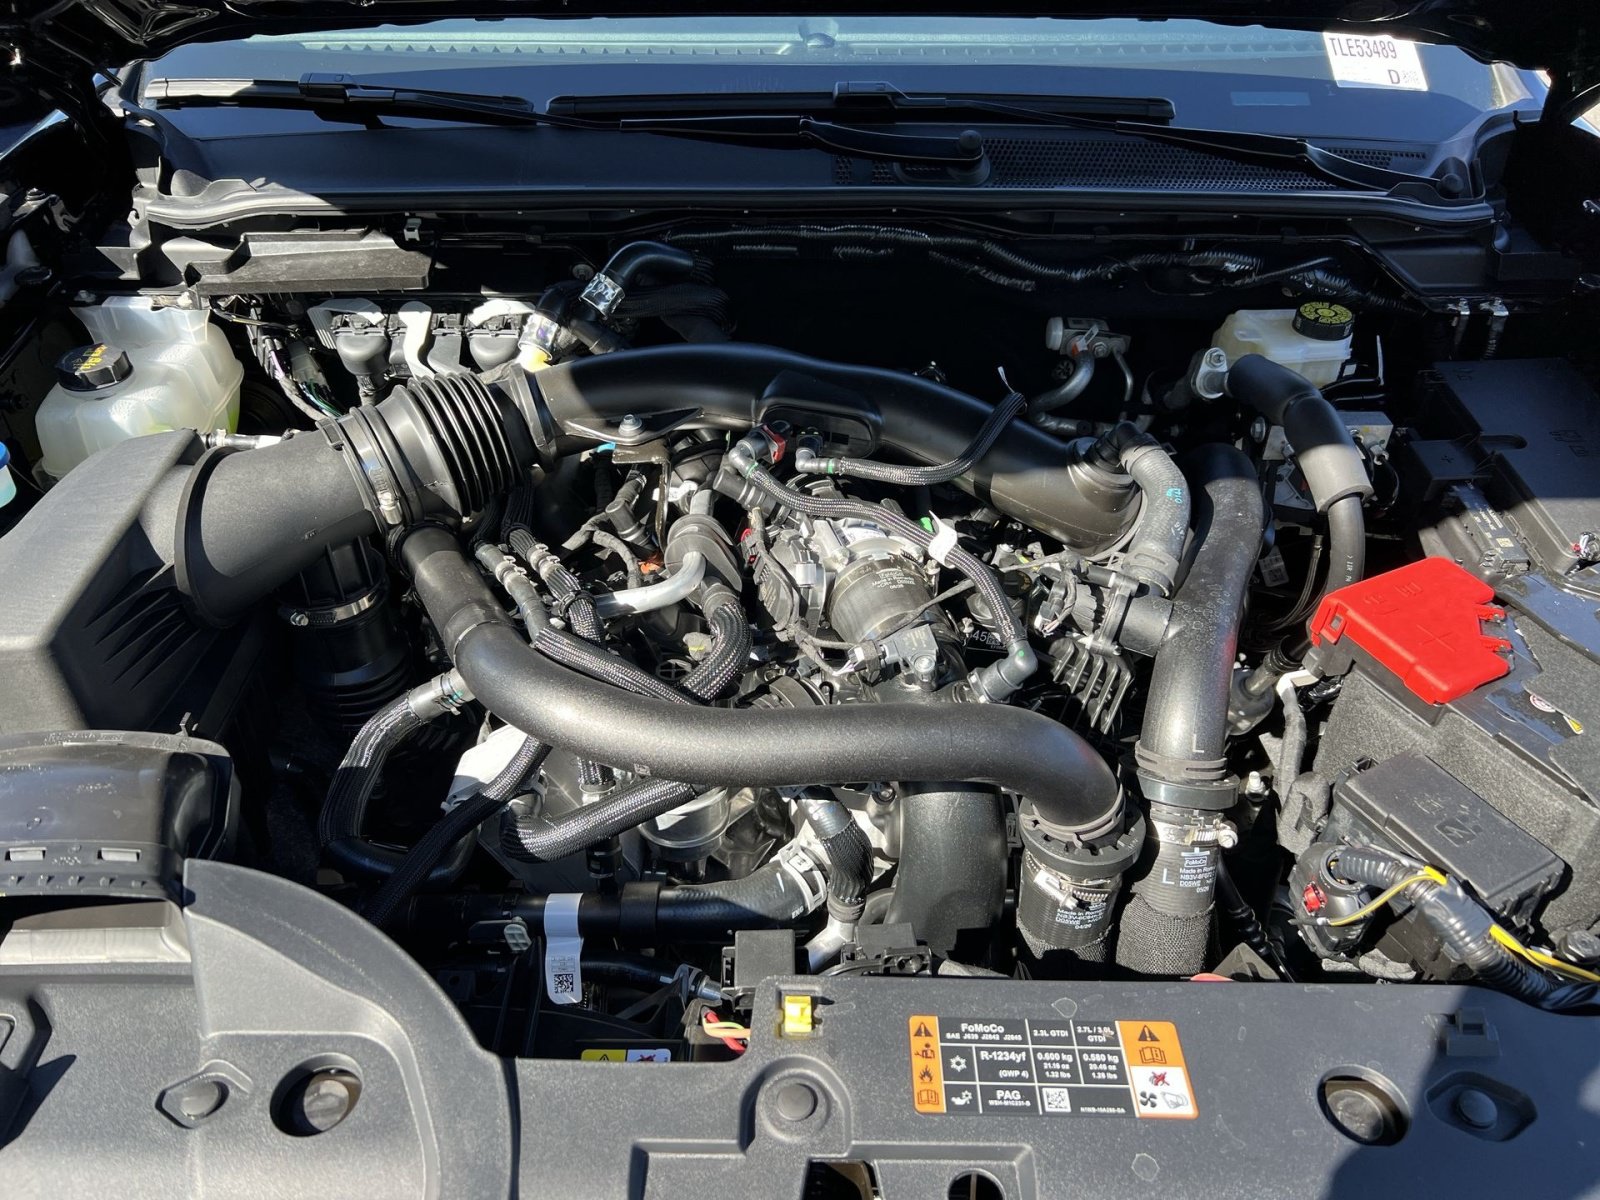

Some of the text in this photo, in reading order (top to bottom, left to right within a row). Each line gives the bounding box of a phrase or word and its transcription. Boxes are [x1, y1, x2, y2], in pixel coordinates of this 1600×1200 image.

[1328, 37, 1398, 59] TLE53489
[1388, 69, 1401, 84] D
[1192, 734, 1205, 753] L
[1162, 868, 1175, 885] L
[961, 1023, 1005, 1033] FoMoCo
[980, 1051, 1026, 1063] R-1234yf
[1037, 1052, 1073, 1062] 0.600 kg
[1082, 1053, 1119, 1063] 0.580 kg
[999, 1070, 1029, 1079] (GWP 4)
[996, 1090, 1021, 1100] PAG
